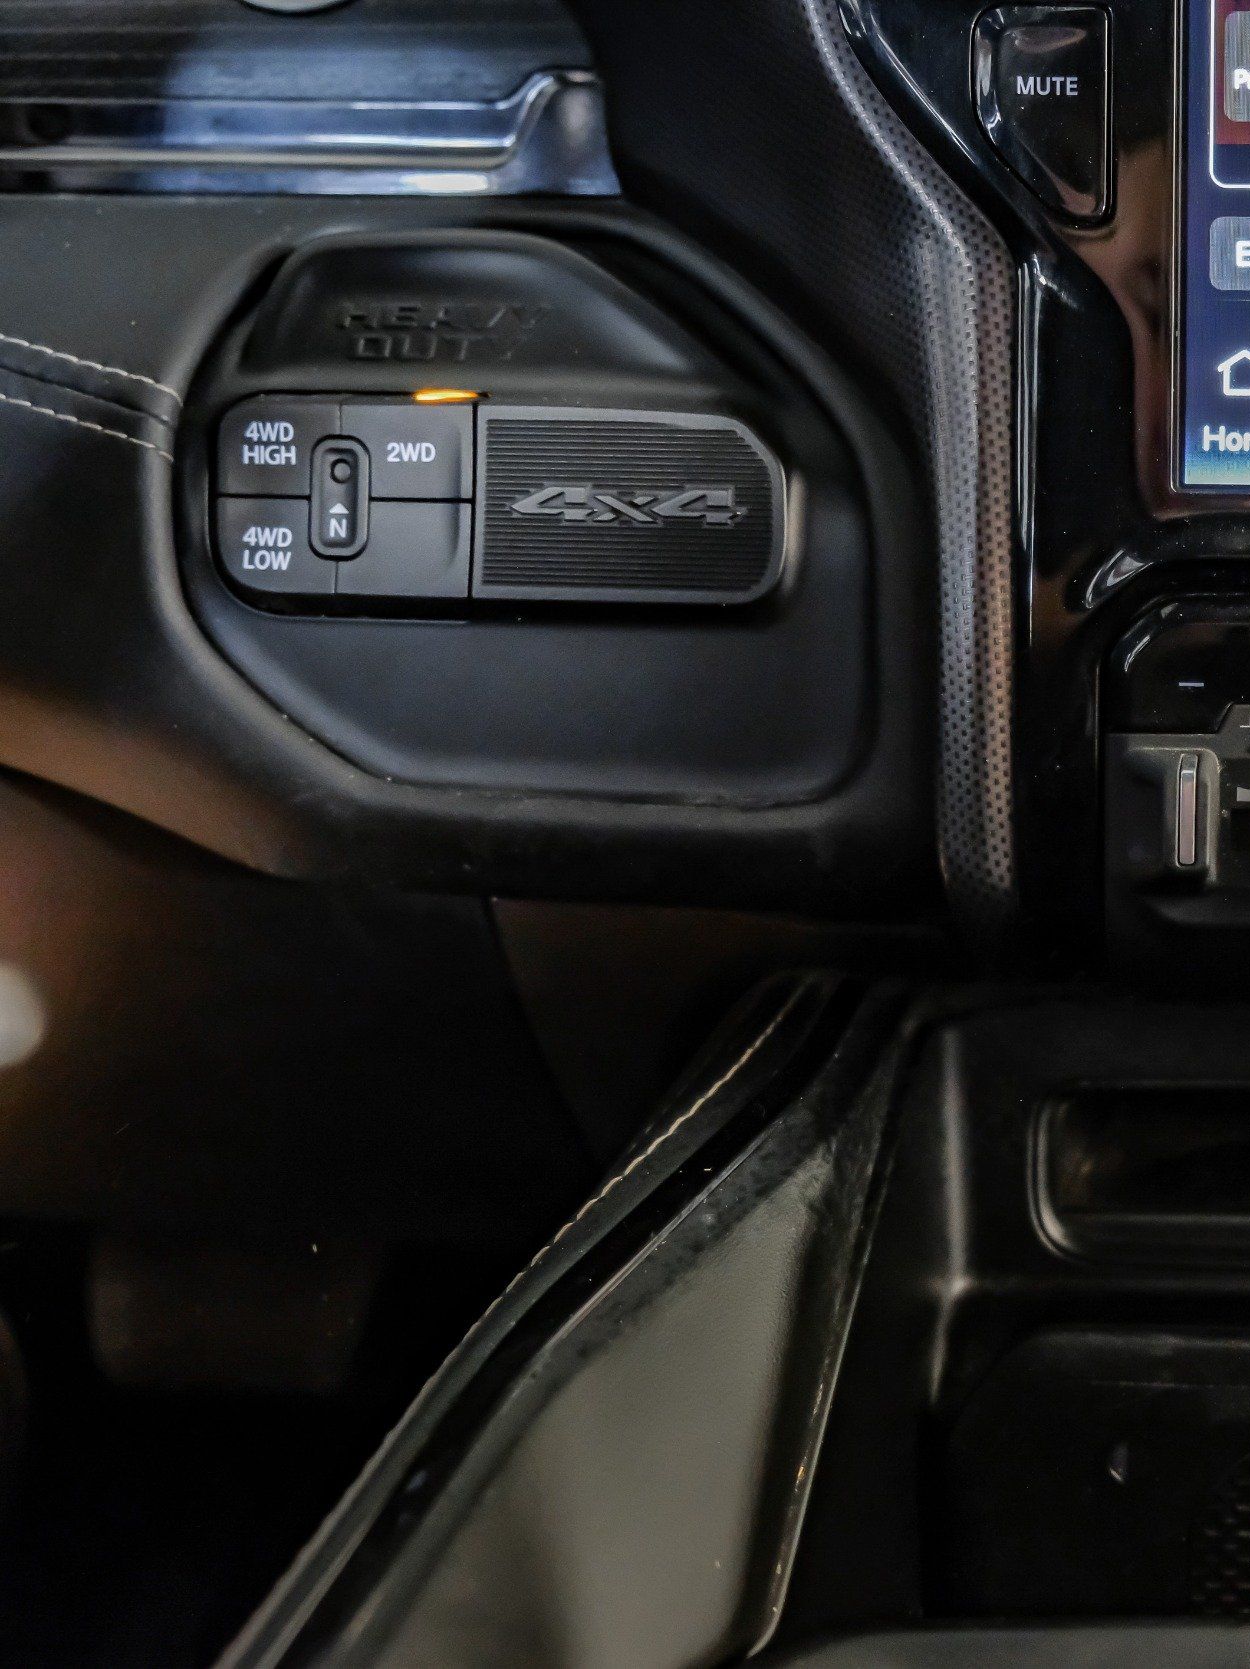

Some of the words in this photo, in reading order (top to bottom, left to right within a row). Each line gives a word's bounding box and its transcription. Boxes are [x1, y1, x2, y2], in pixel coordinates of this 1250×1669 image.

[1016, 75, 1079, 96] MUTE
[245, 422, 295, 443] 4WD
[242, 445, 296, 466] HIGH
[386, 442, 436, 463] 2WD
[242, 527, 292, 548] 4WD
[329, 519, 346, 539] N
[242, 549, 291, 571] LOW
